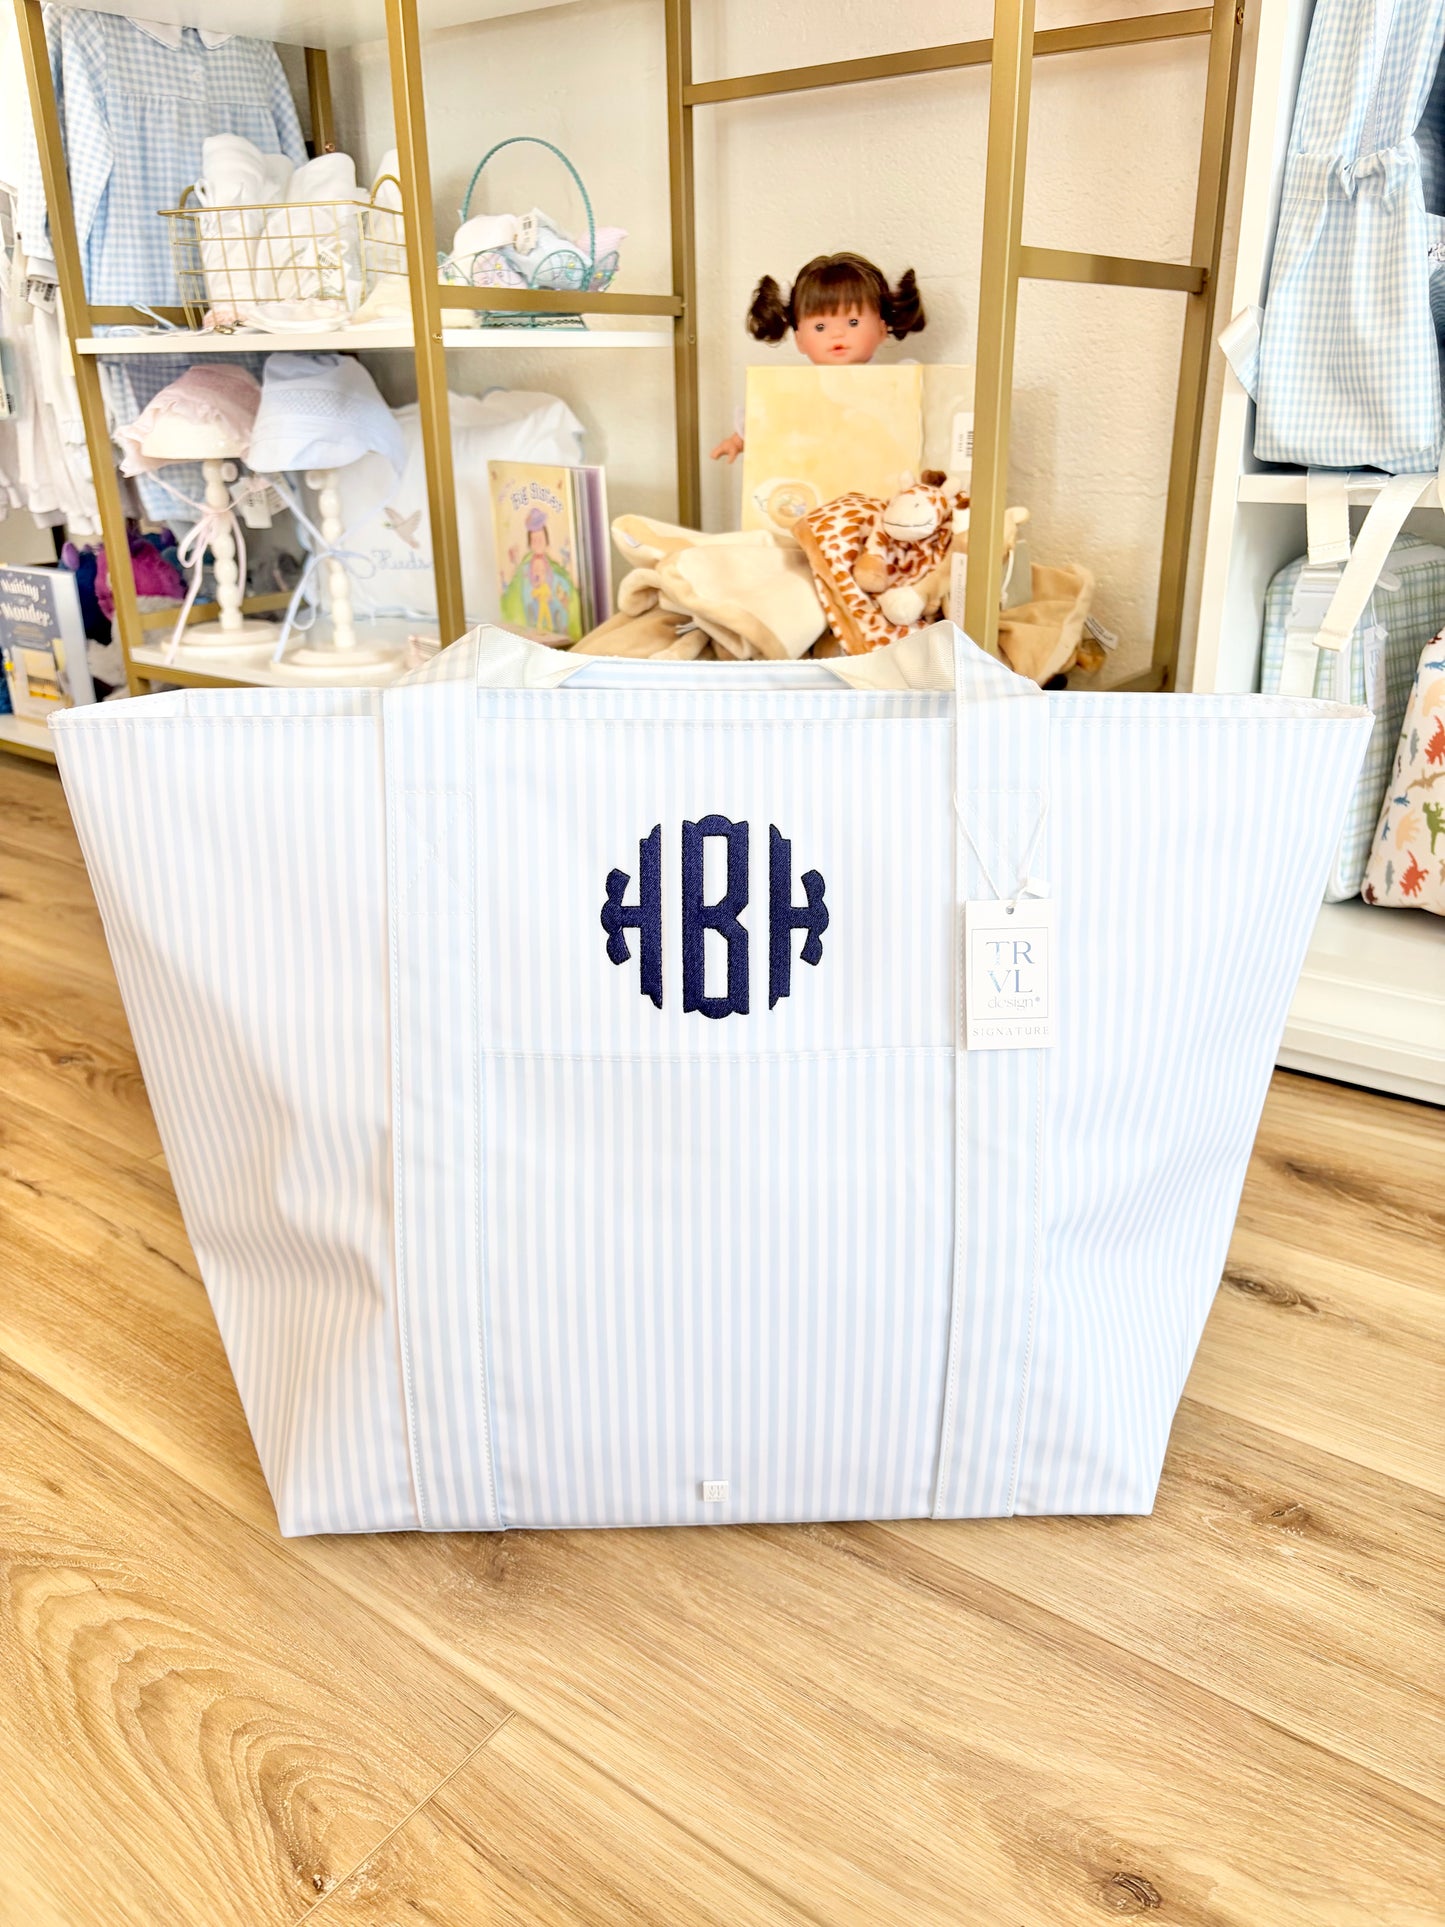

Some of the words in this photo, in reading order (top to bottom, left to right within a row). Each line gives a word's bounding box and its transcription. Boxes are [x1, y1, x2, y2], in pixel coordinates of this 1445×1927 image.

[985, 940, 1035, 965] TR
[987, 969, 1033, 993] VL
[972, 1026, 1049, 1038] SIGNATURE
